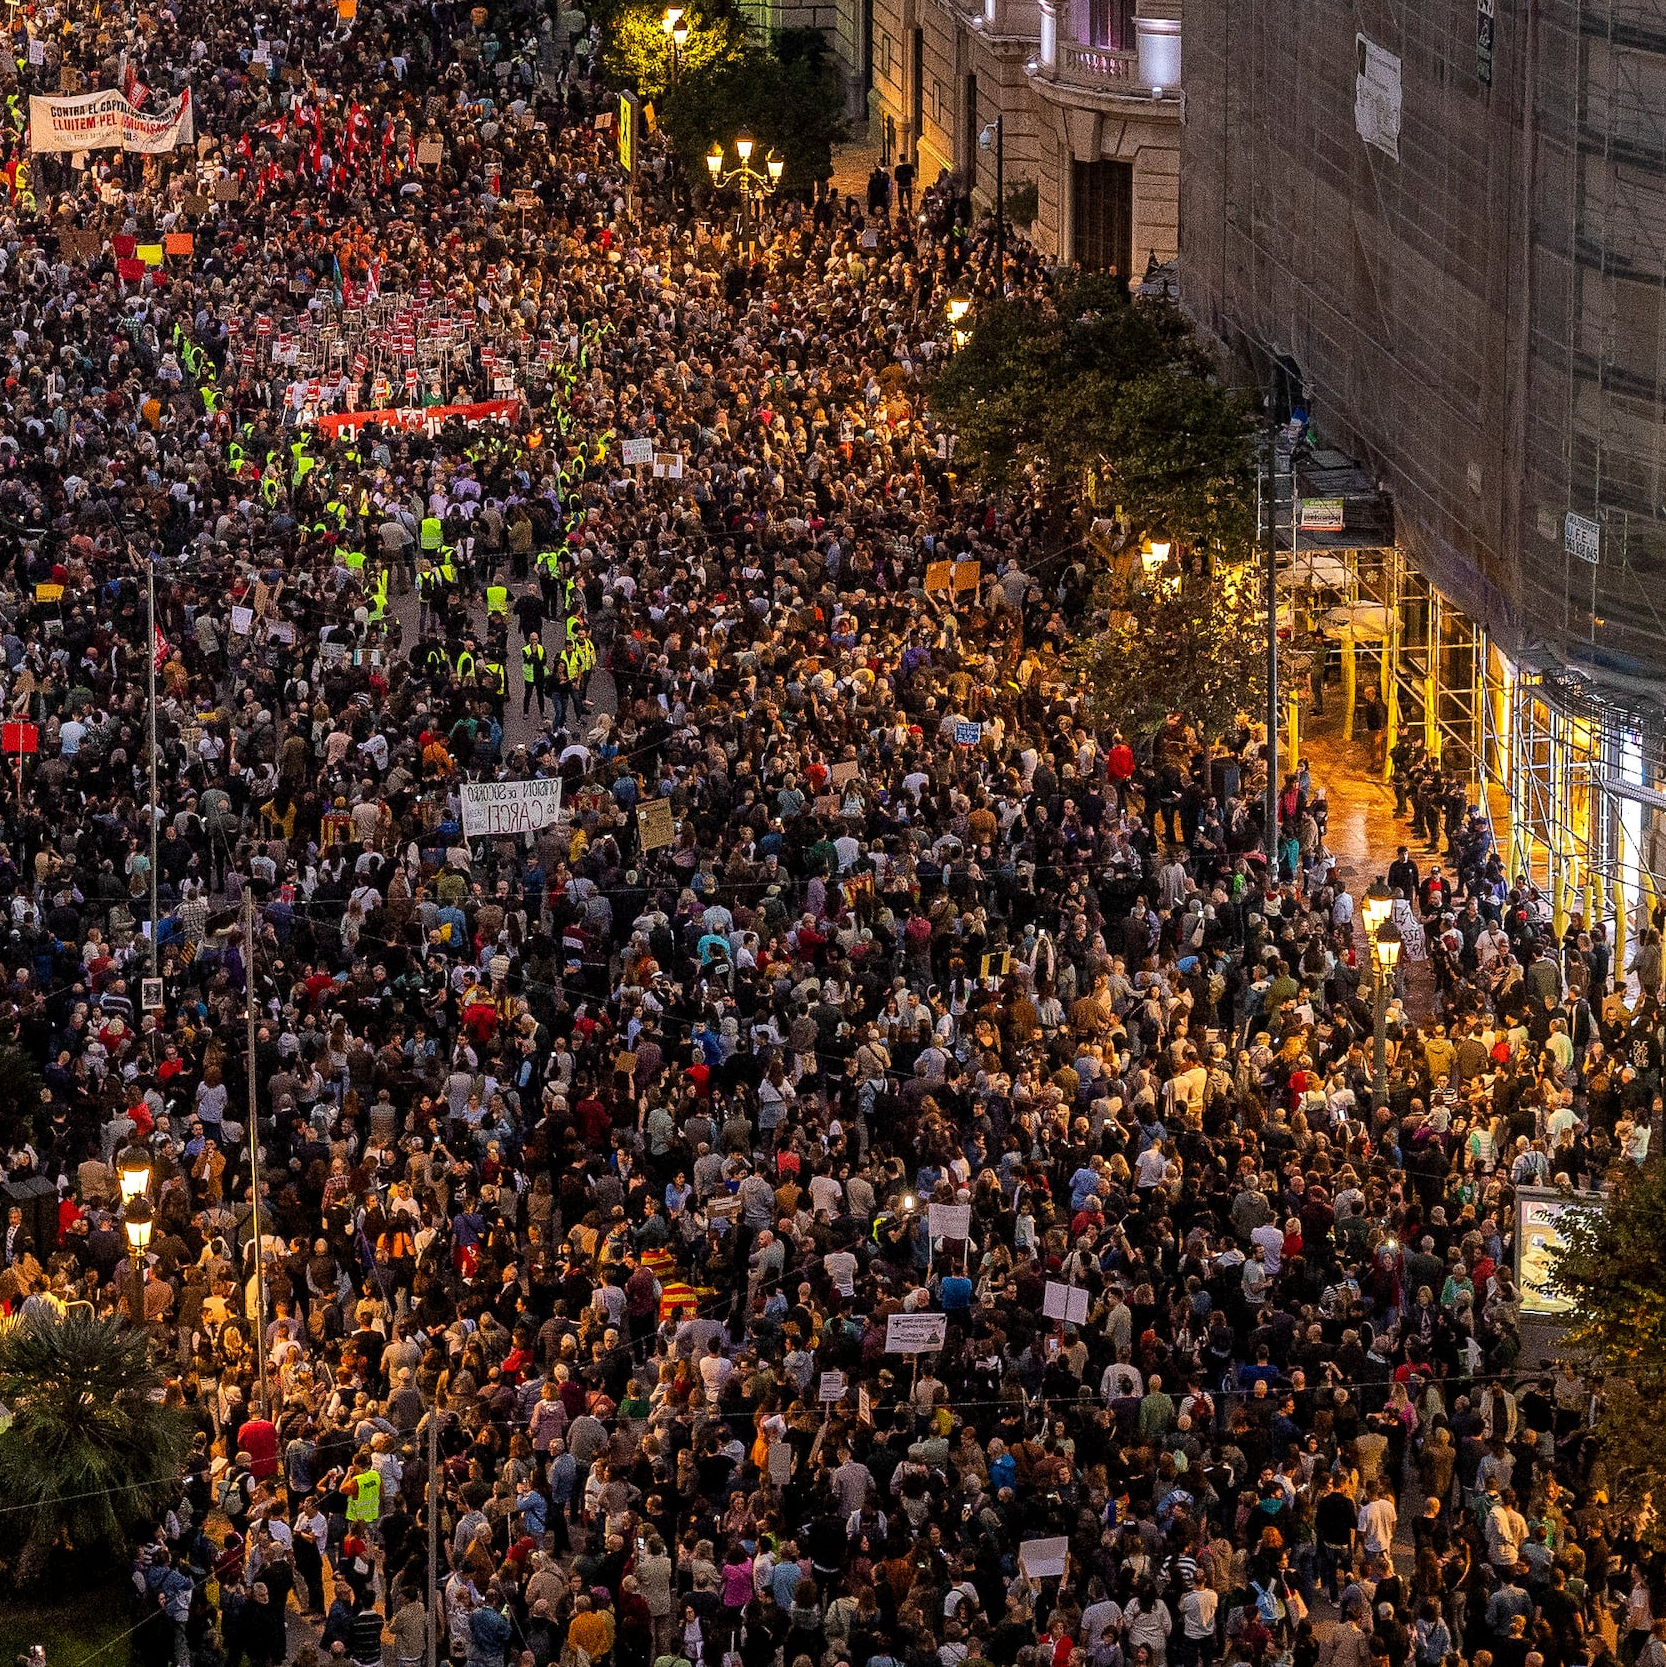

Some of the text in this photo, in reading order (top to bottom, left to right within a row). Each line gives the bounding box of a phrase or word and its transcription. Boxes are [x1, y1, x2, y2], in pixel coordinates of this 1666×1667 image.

[51, 105, 85, 118] CONTRA
[88, 103, 98, 114] EL
[53, 117, 95, 131] LLUITEM
[99, 114, 117, 127] PEL
